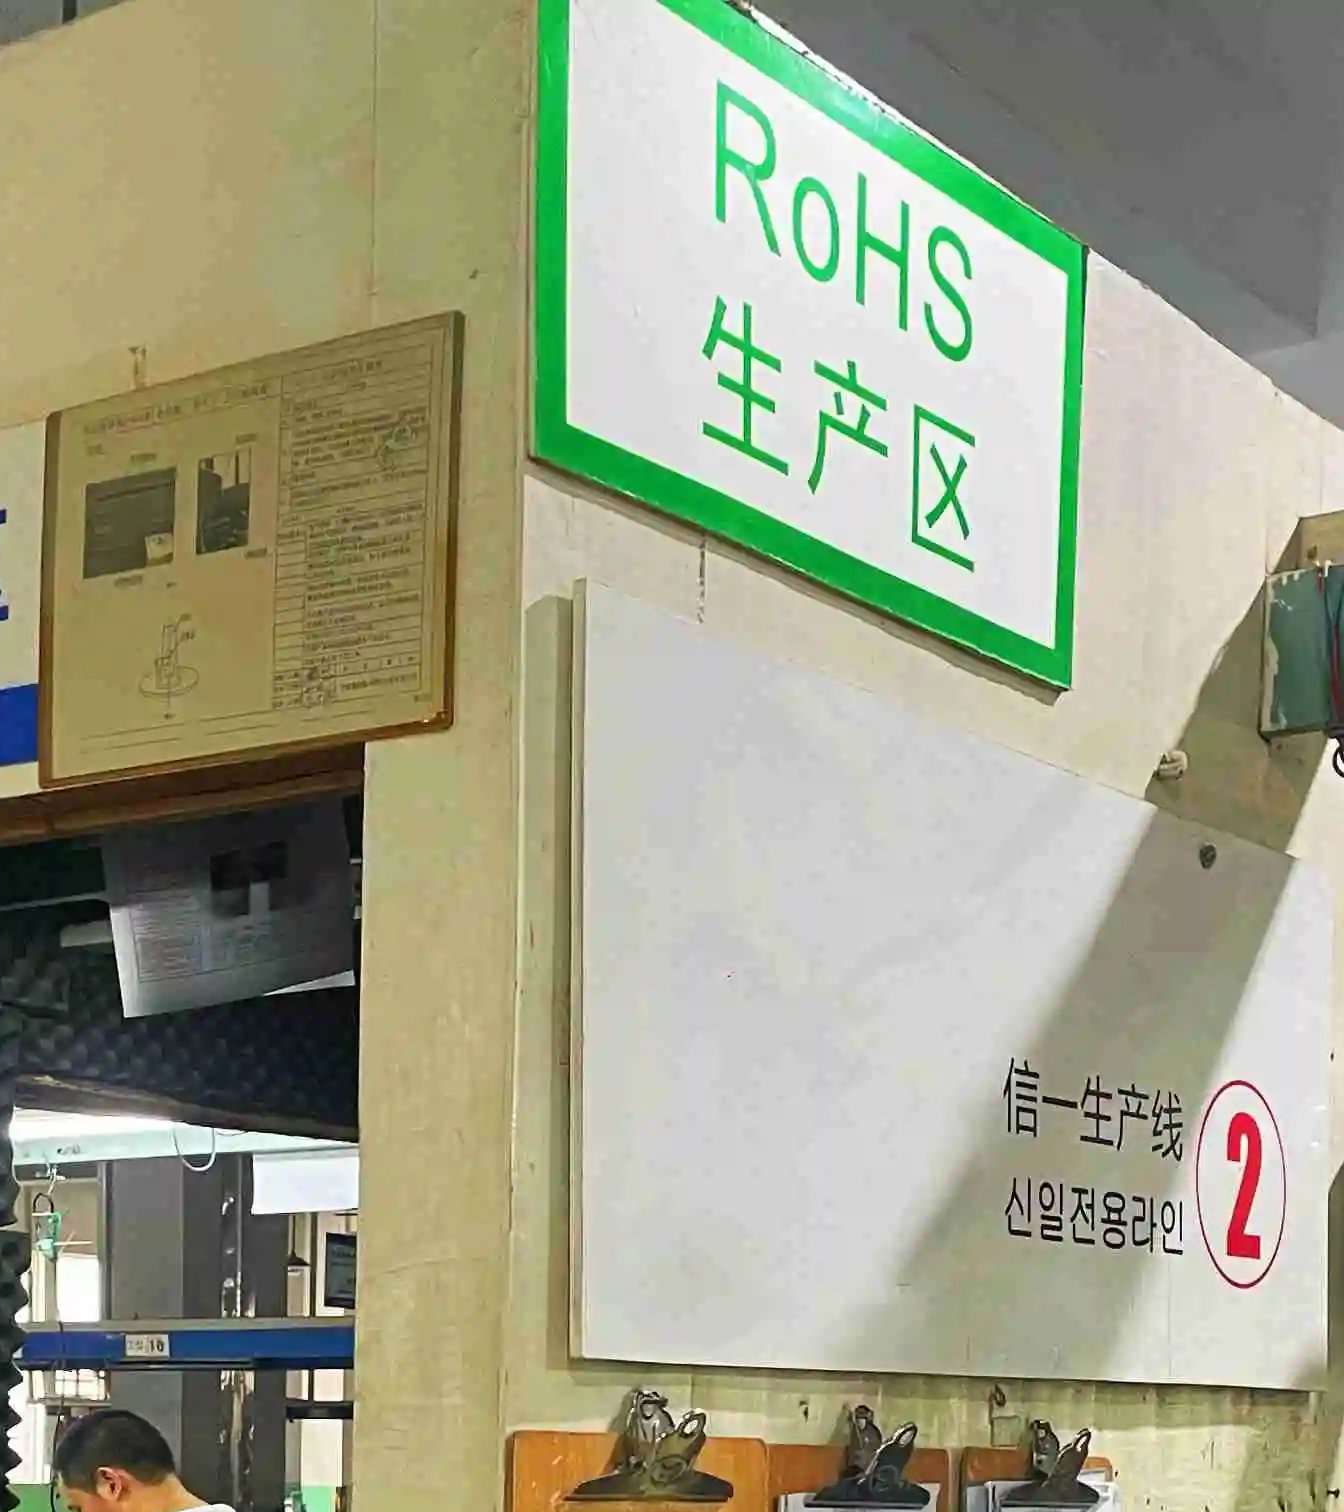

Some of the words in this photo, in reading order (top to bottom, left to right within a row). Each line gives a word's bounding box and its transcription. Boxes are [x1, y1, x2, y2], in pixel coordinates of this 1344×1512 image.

[715, 81, 973, 362] RoHS
[701, 296, 976, 572] 生产区
[1003, 1057, 1184, 1162] 信一生产线
[1004, 1177, 1184, 1256] 신일전용라인
[1226, 1112, 1263, 1260] 2
